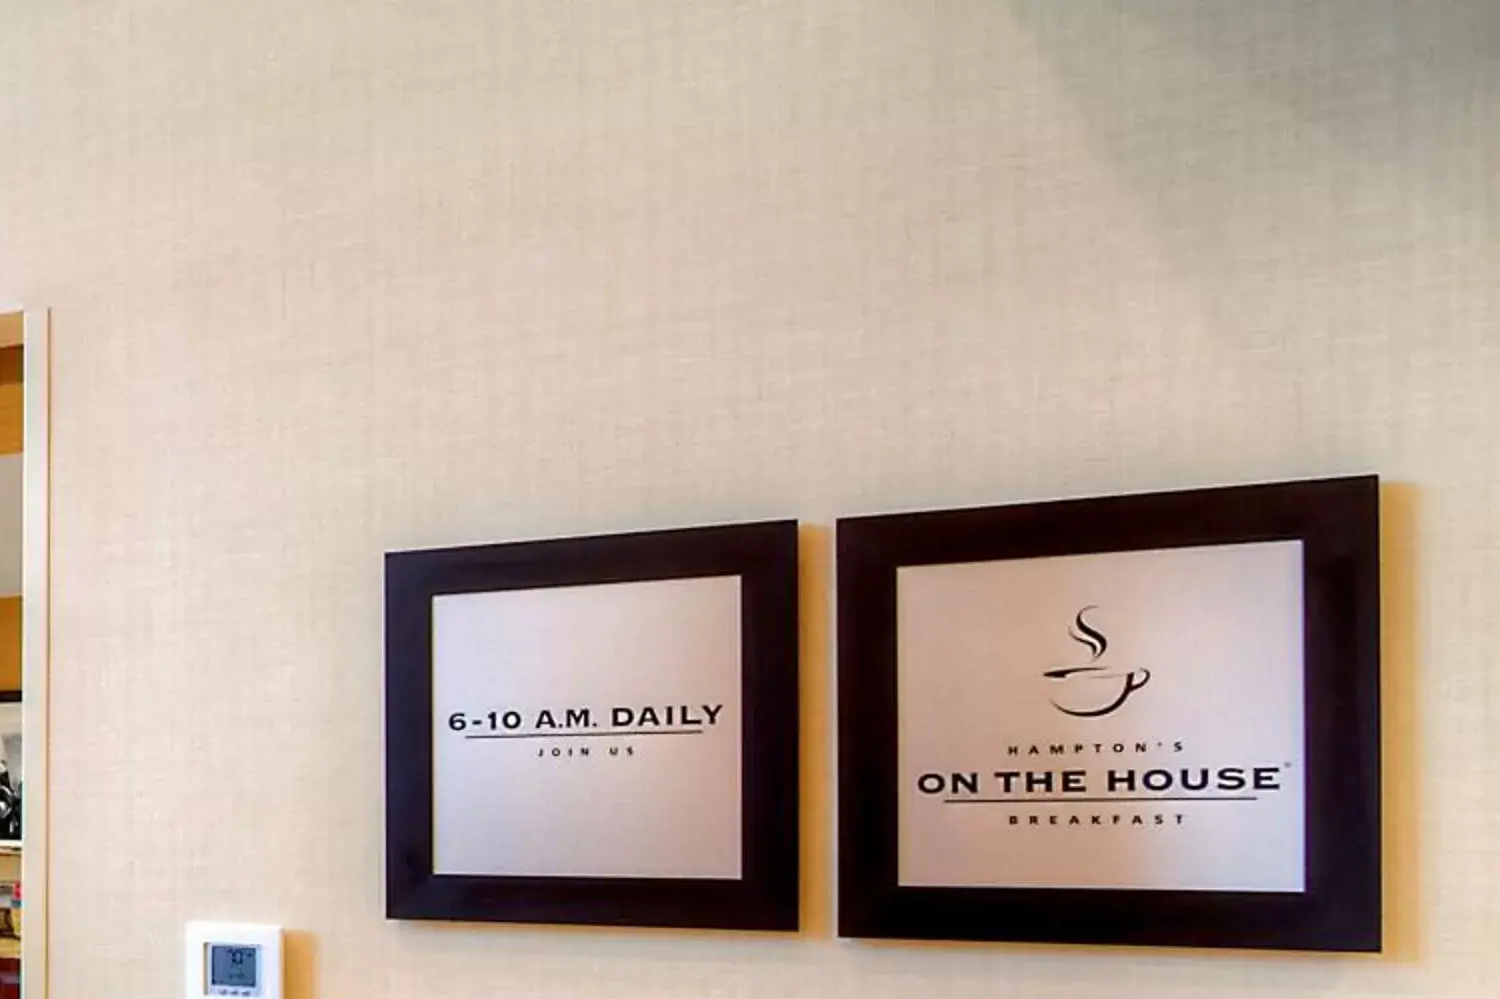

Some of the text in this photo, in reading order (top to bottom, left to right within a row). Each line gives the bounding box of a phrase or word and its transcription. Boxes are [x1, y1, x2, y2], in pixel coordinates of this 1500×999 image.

[448, 704, 723, 731] 6-10 A.M. DAILY
[537, 745, 636, 758] JOIN US
[1008, 741, 1184, 756] HAMPTON'S
[917, 771, 979, 795] ON
[993, 769, 1087, 793] THE
[1009, 813, 1185, 828] BREAKFAST
